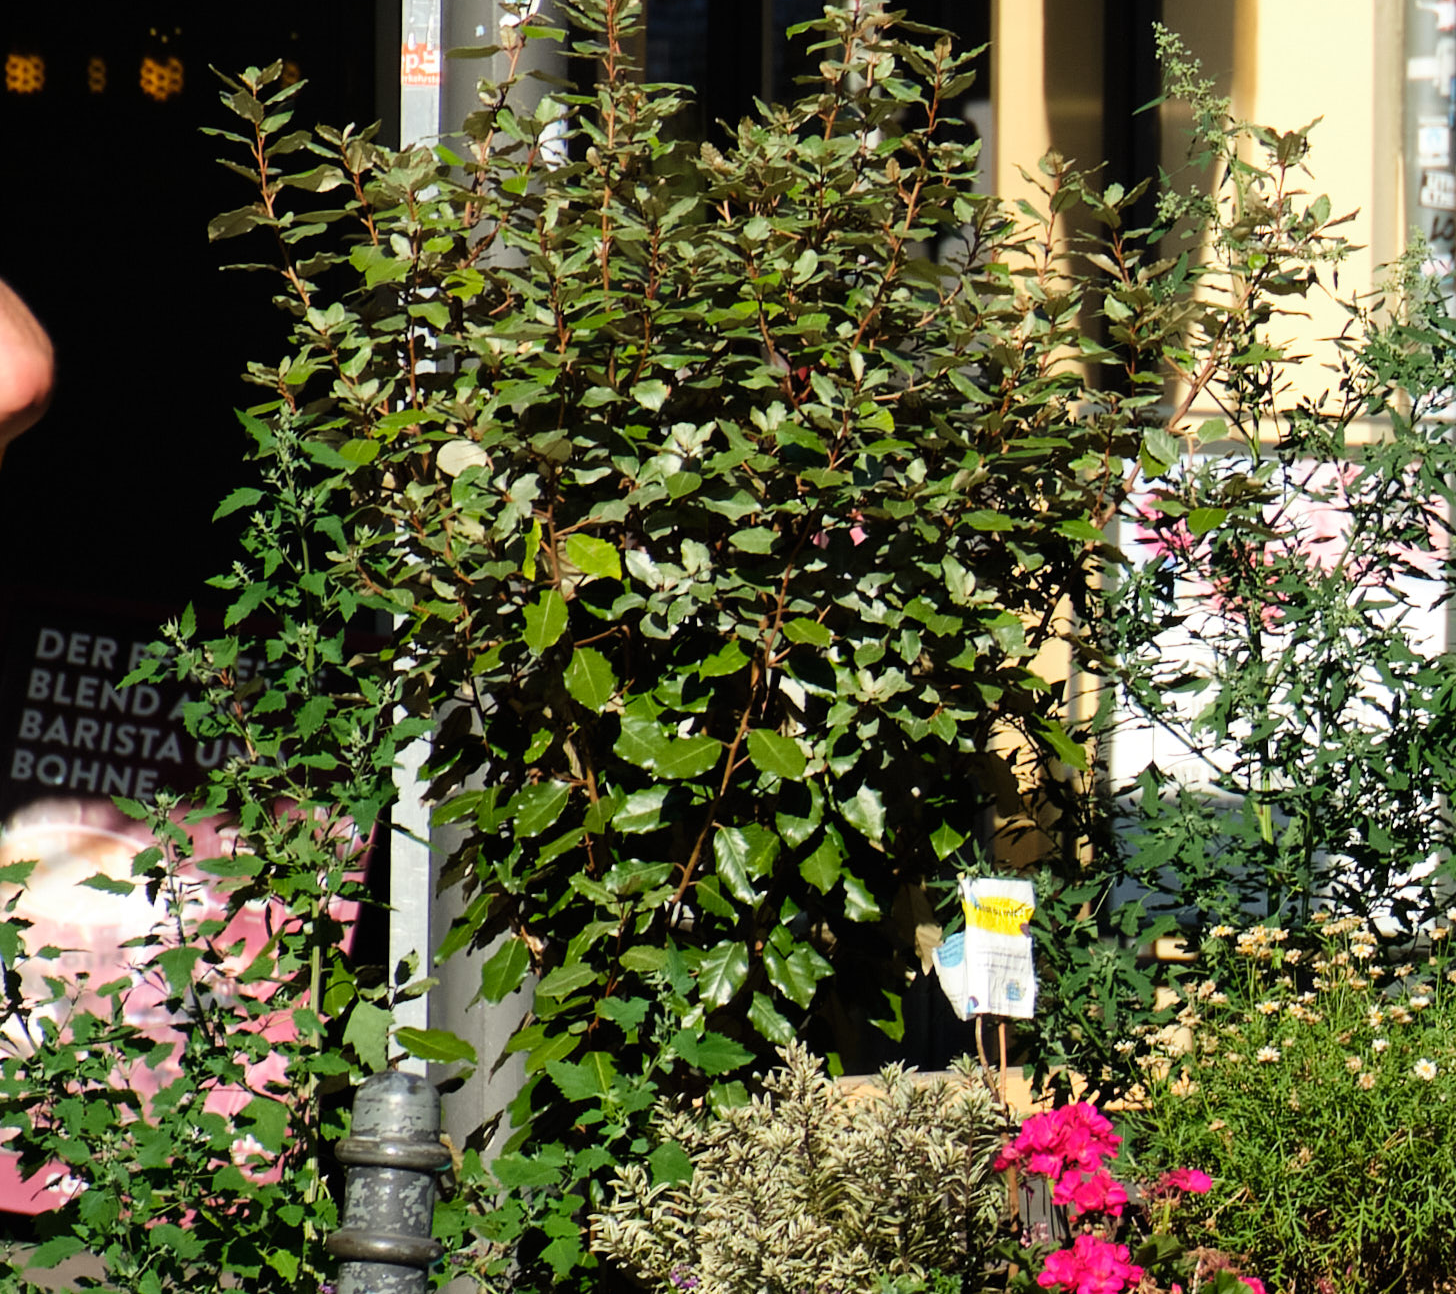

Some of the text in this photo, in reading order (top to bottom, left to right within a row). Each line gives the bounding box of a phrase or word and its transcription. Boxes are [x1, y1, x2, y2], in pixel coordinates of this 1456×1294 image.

[36, 627, 118, 671] DER
[27, 667, 161, 718] BLEND
[18, 708, 183, 765] BARISTA
[10, 748, 160, 801] BOHNE
